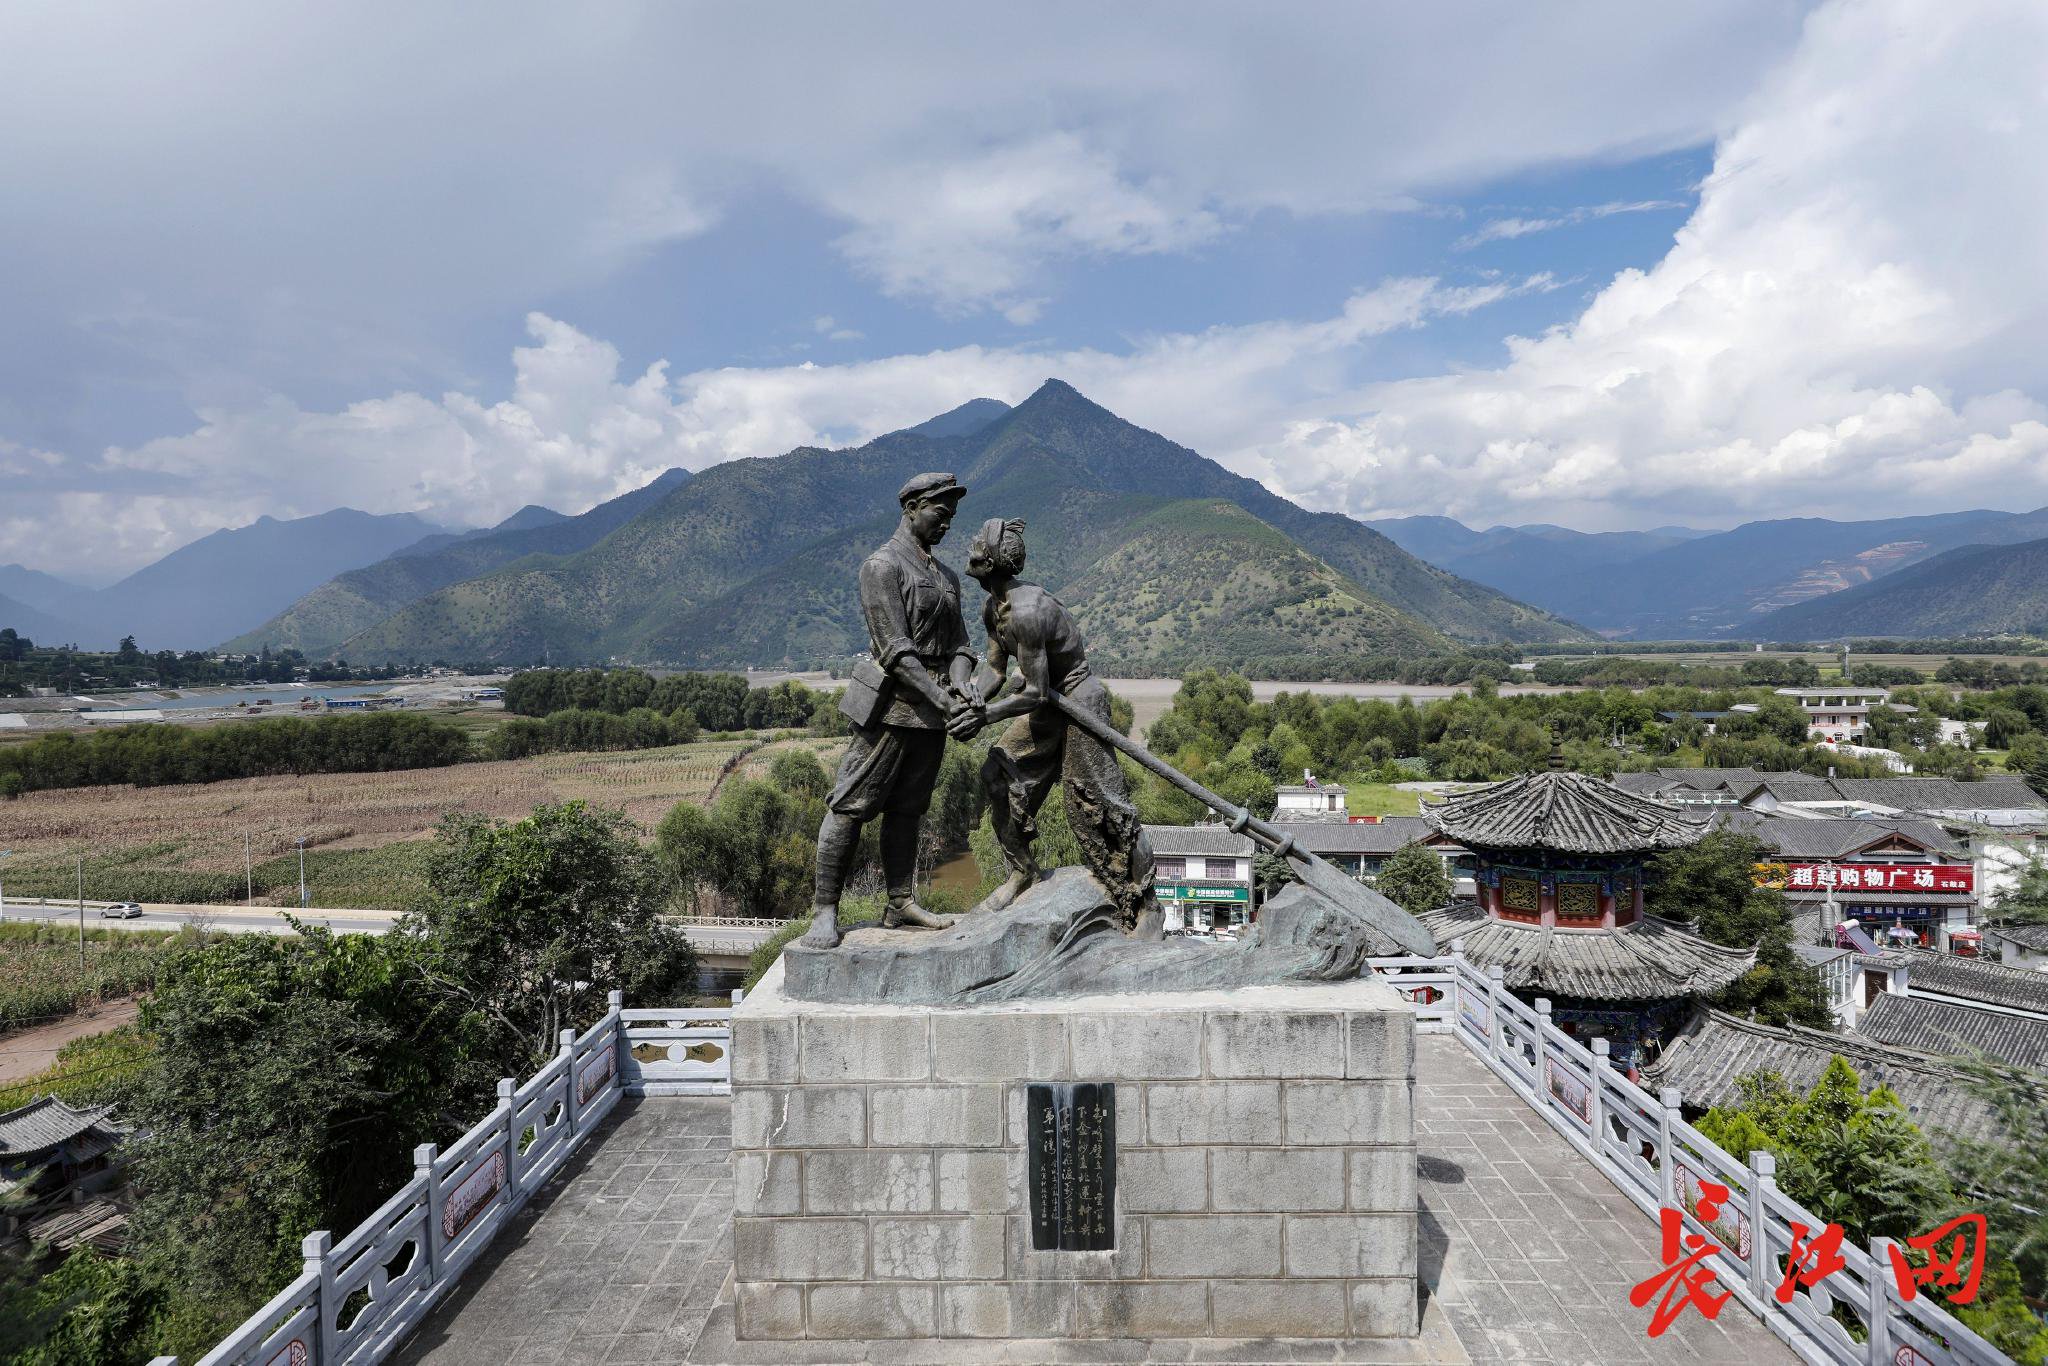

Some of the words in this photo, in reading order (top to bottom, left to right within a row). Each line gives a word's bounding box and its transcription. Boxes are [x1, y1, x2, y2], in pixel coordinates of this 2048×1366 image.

[1793, 868, 1935, 888] 超越购物广场
